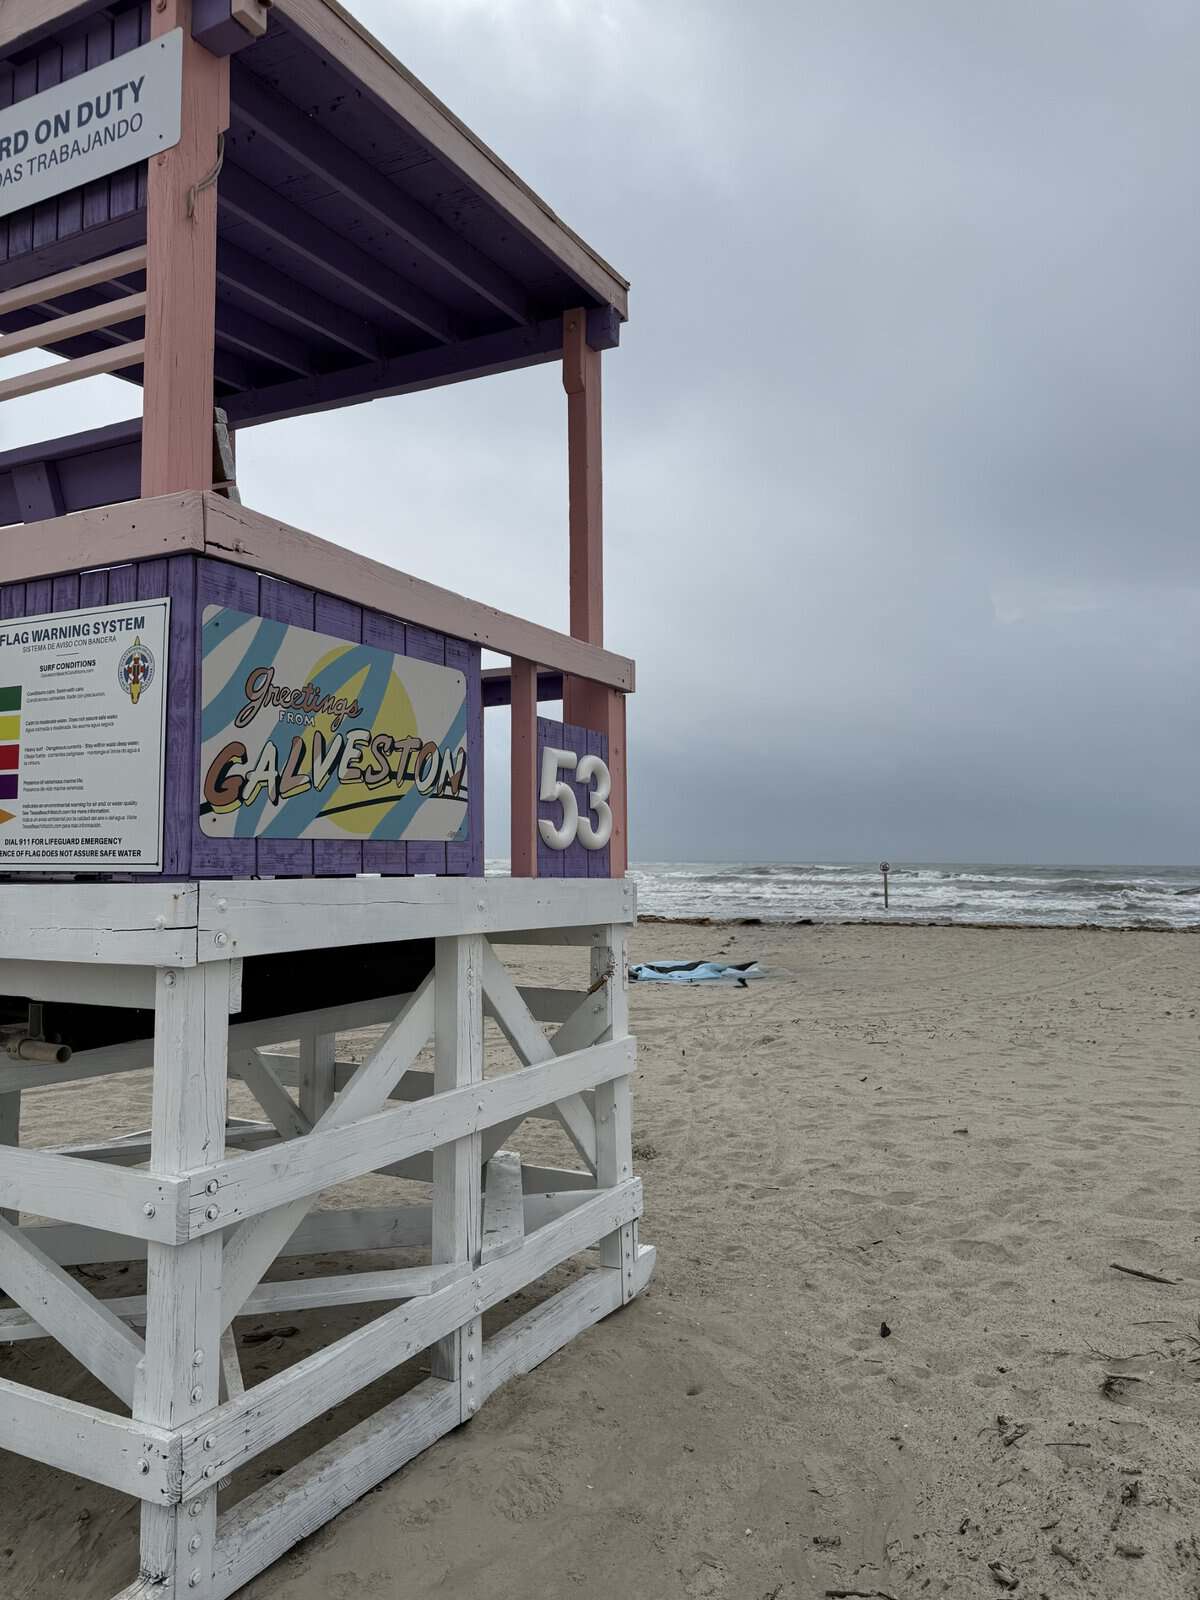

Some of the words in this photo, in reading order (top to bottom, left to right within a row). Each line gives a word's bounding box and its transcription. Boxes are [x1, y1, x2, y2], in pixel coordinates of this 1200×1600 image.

[35, 109, 70, 145] ON
[77, 75, 145, 129] DUTY
[26, 112, 143, 177] TRABAJANDO
[0, 631, 29, 647] FLAG
[31, 622, 90, 642] WARNING
[93, 616, 145, 635] SYSTEM
[22, 644, 46, 653] SISTEMA
[47, 643, 56, 651] DE
[56, 640, 73, 649] AVISO
[74, 638, 87, 647] CON
[87, 635, 117, 645] BANDERA
[40, 663, 55, 672] SURF
[56, 659, 96, 670] CONDITIONS
[234, 667, 364, 731] Greetings
[279, 710, 315, 727] FROM
[204, 727, 467, 814] GALVESTON
[538, 746, 613, 850] 53
[5, 838, 18, 846] DIAL
[81, 837, 121, 845] EMERGENCY
